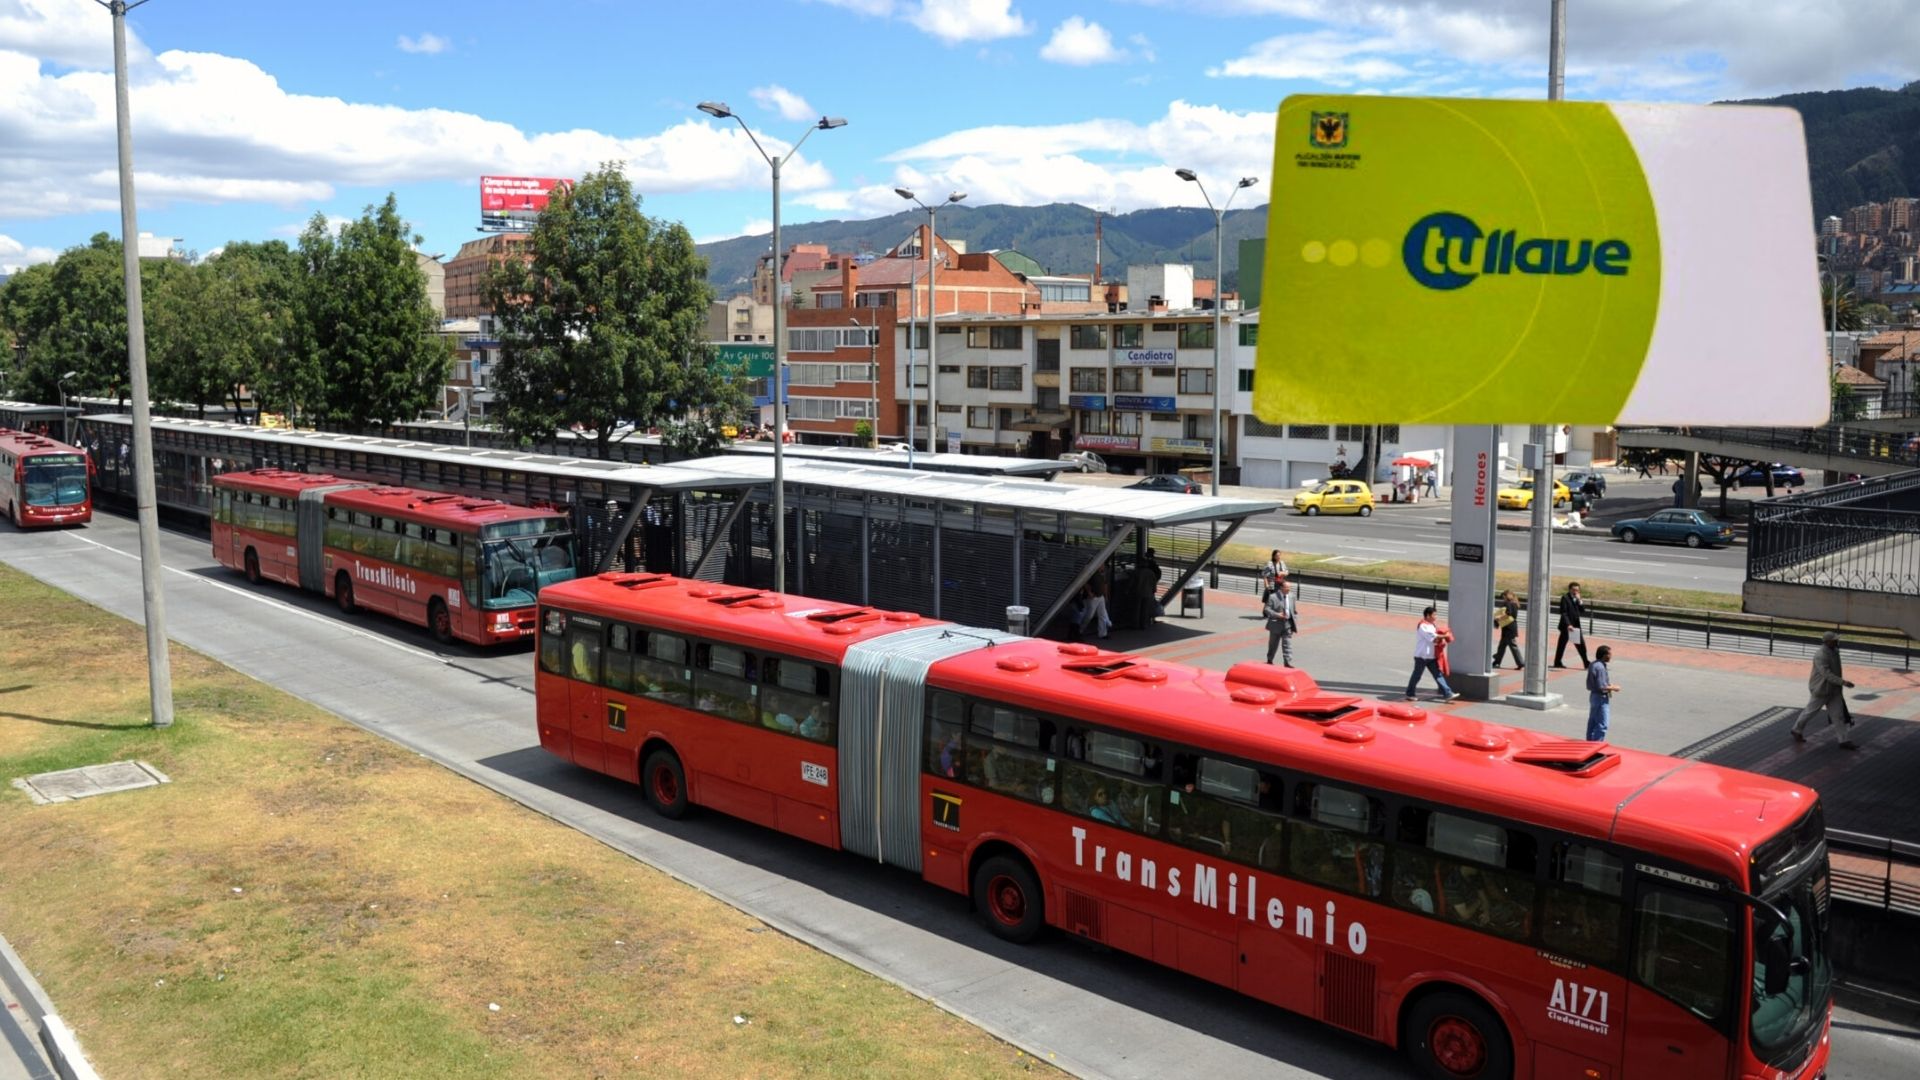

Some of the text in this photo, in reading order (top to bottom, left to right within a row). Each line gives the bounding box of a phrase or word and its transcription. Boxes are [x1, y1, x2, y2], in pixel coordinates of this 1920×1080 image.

[1128, 350, 1174, 361] Cendiatra
[1474, 452, 1487, 506] Héroes
[355, 559, 416, 595] TransMilenio
[1072, 826, 1368, 956] TransMilenio
[1549, 977, 1609, 1023] A171
[1547, 1011, 1608, 1036] Ciudadmóvil
